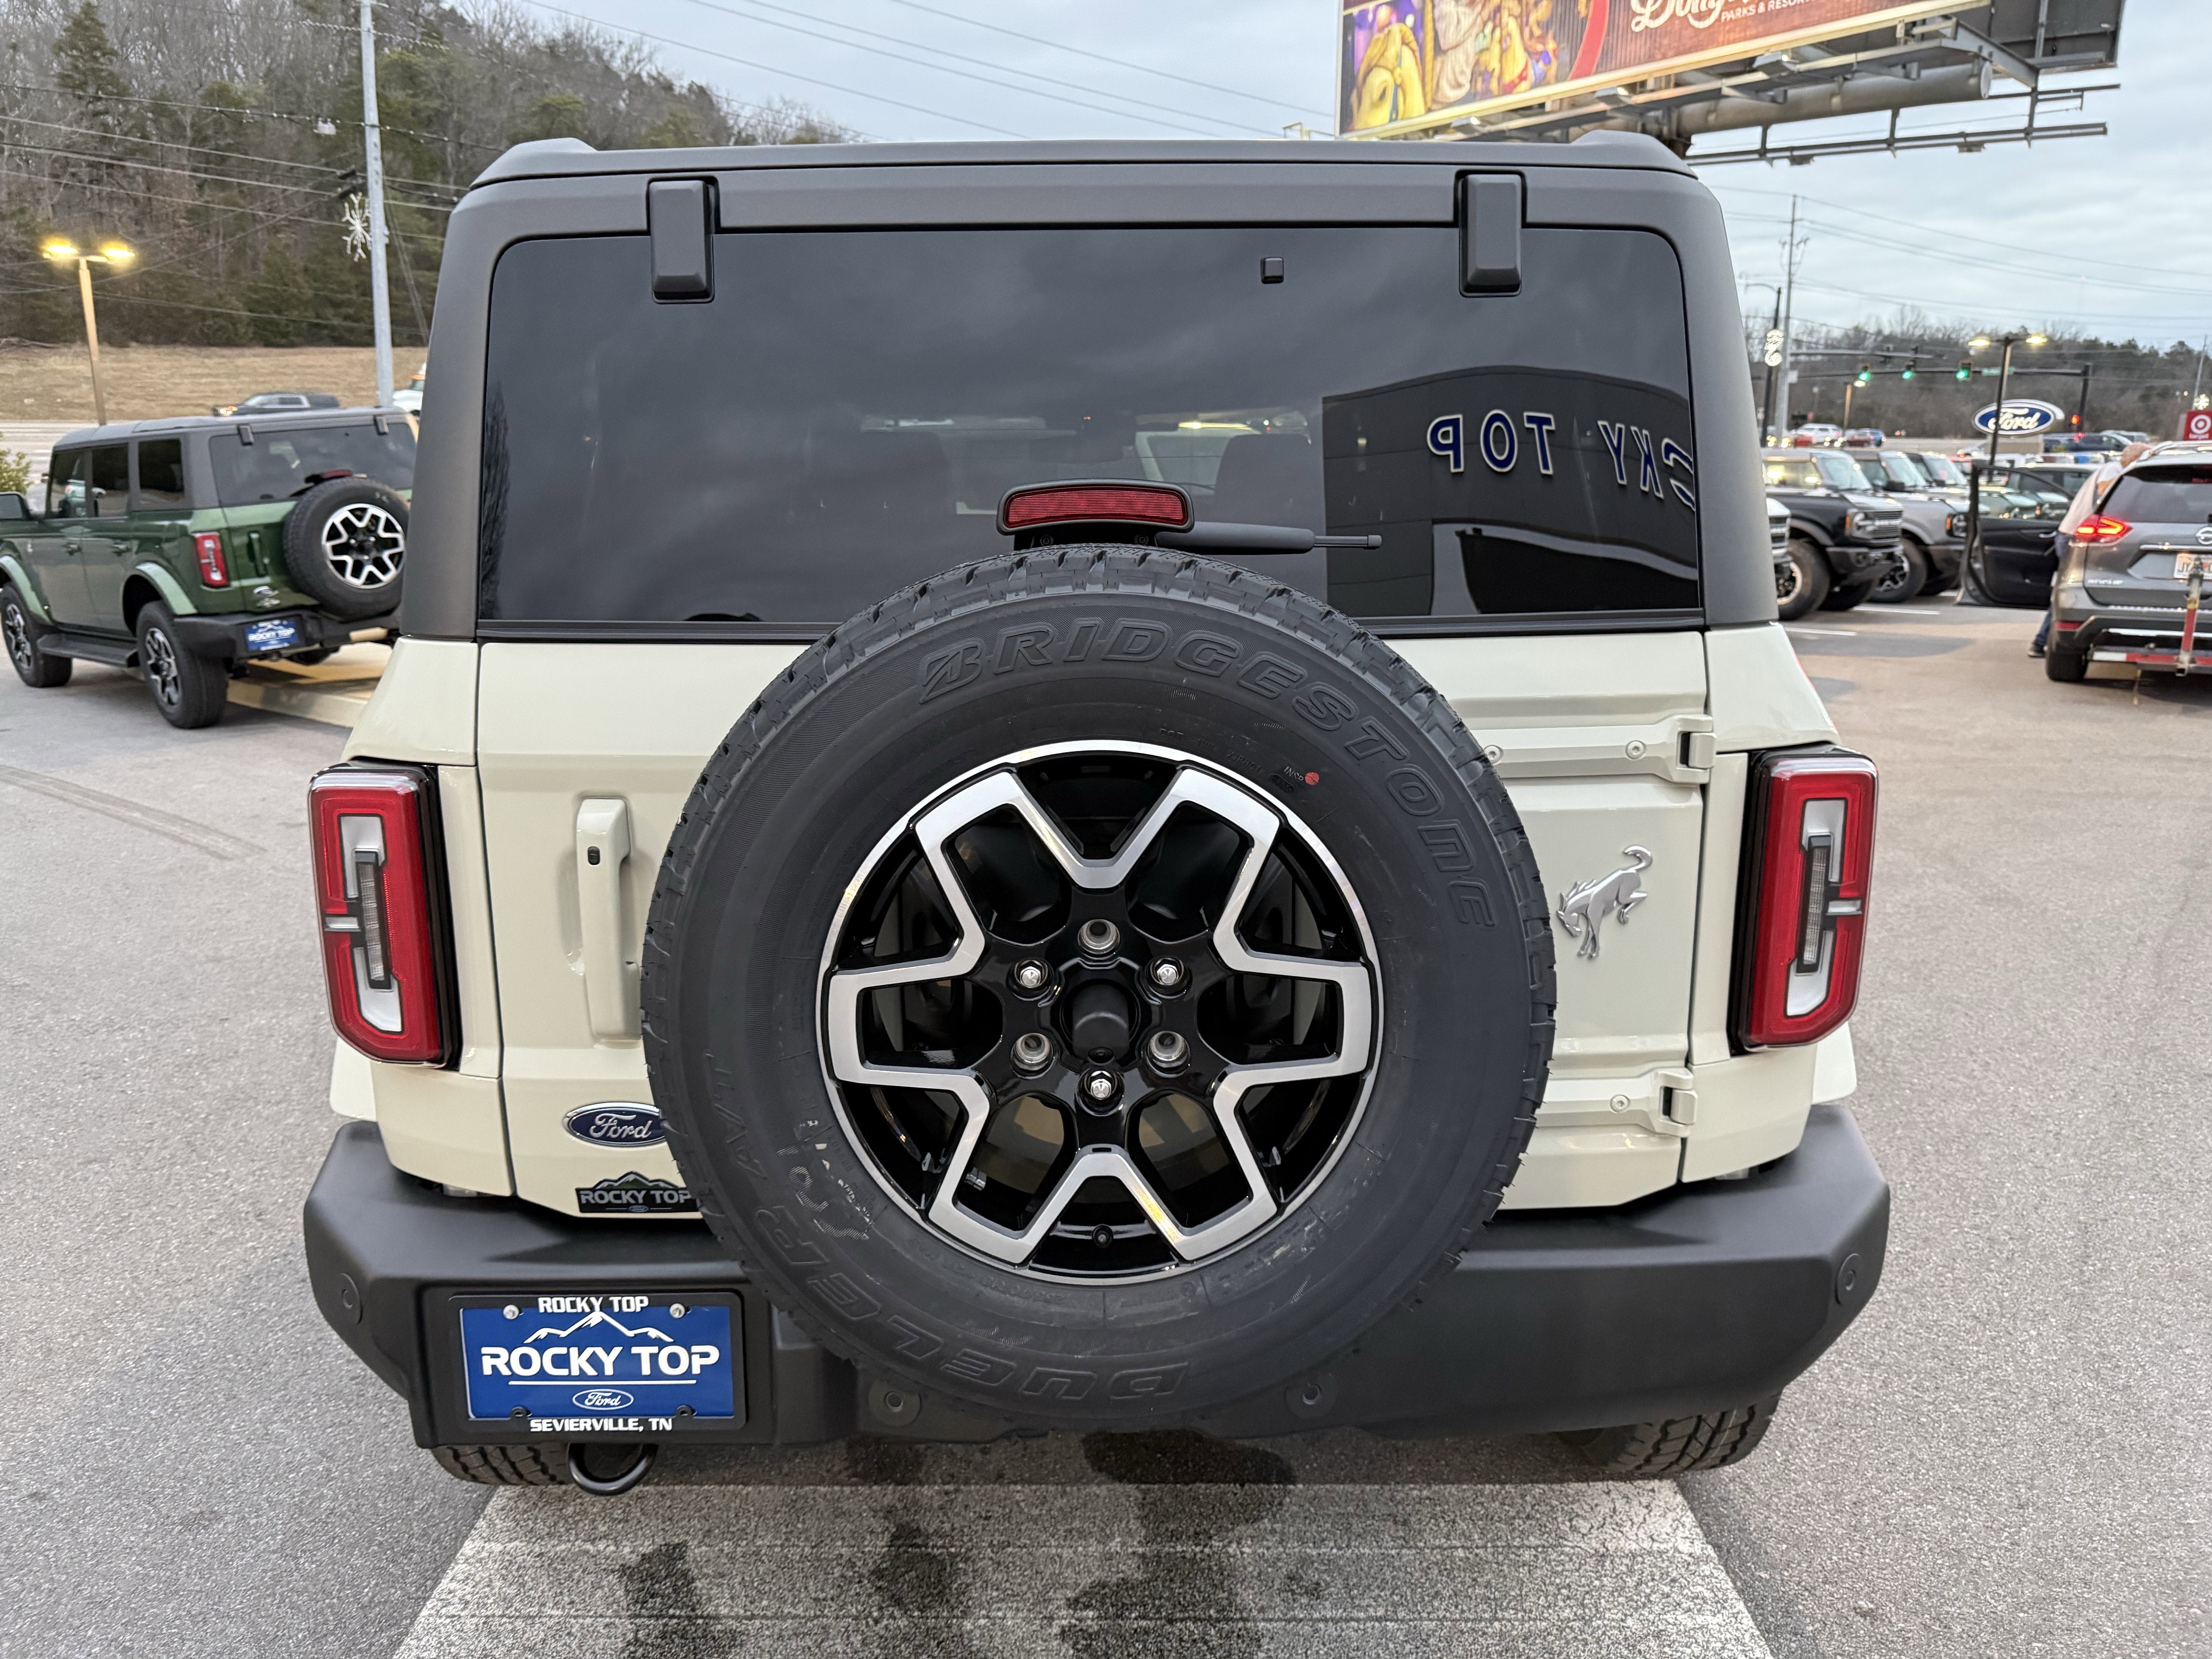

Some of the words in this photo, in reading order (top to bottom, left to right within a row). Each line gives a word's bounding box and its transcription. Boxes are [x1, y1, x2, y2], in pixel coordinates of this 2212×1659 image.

[1721, 4, 1756, 22] PARKS
[1757, 2, 1765, 14] &
[1988, 408, 2041, 430] Ford
[919, 618, 1496, 927] BRIDGESTONE
[589, 1113, 653, 1139] Ford
[580, 1190, 647, 1204] ROCKY
[650, 1190, 692, 1204] TOP
[538, 1297, 603, 1312] ROCKY
[608, 1296, 649, 1312] TOP
[754, 1205, 1189, 1400] DUELER
[481, 1346, 623, 1376] ROCKY
[631, 1345, 720, 1376] TOP
[584, 1392, 621, 1406] Ford
[530, 1418, 644, 1432] SEVIERVILLE,
[648, 1418, 673, 1431] TN
